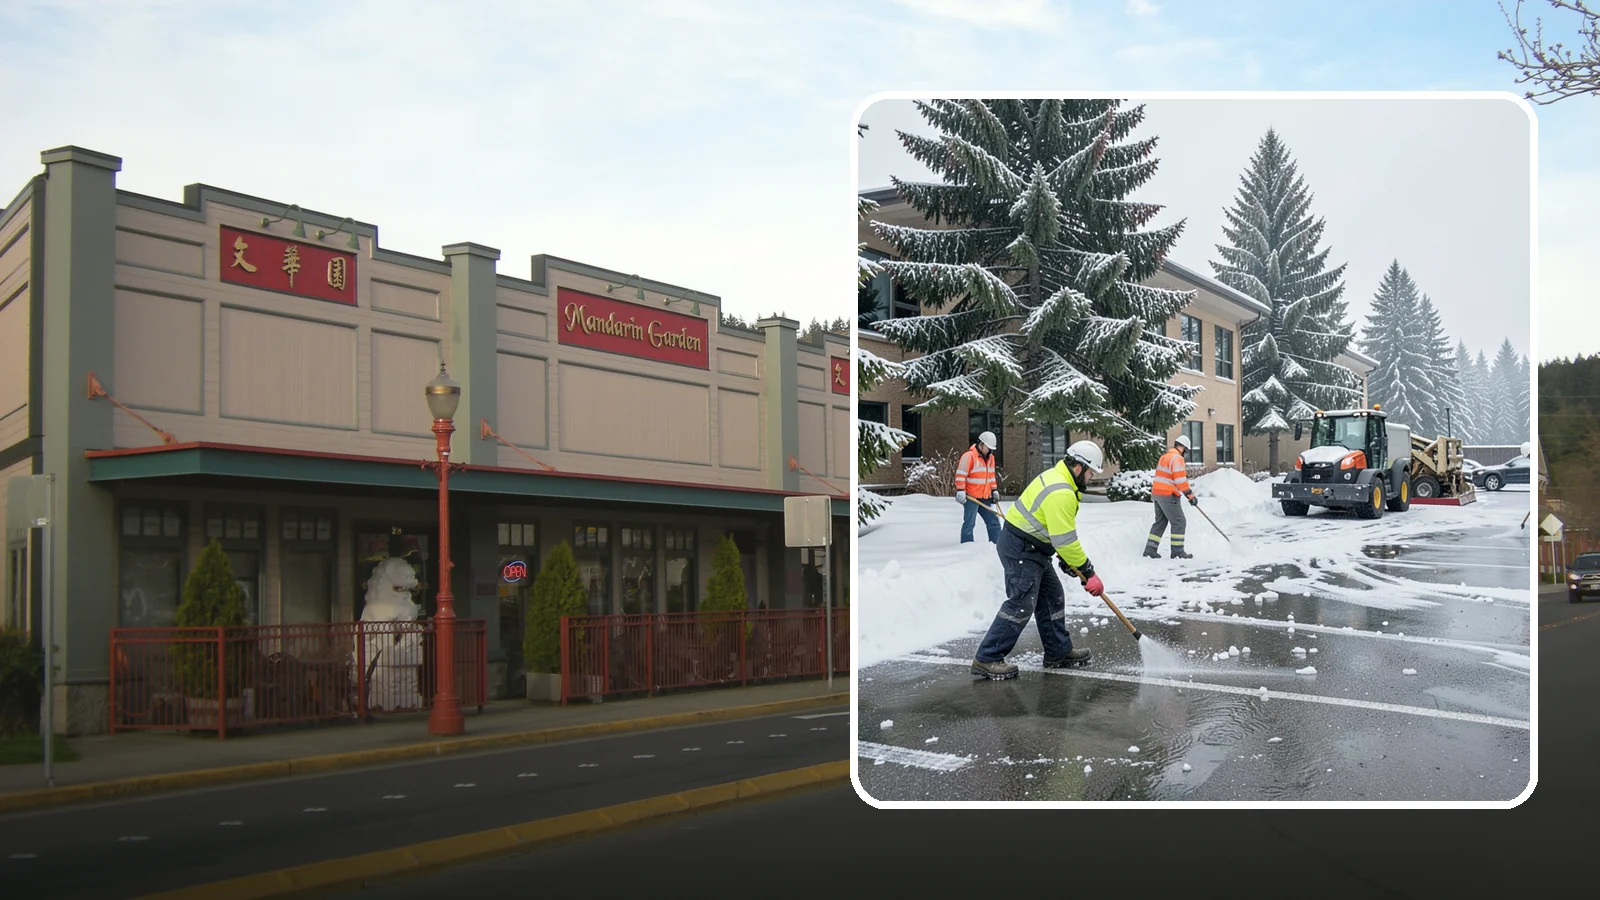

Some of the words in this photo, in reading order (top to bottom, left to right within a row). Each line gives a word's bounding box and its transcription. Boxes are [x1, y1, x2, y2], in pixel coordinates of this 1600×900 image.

[231, 235, 347, 291] 文華園
[564, 302, 644, 341] Mandarin
[647, 320, 702, 352] Garden
[503, 565, 526, 578] OPEN
